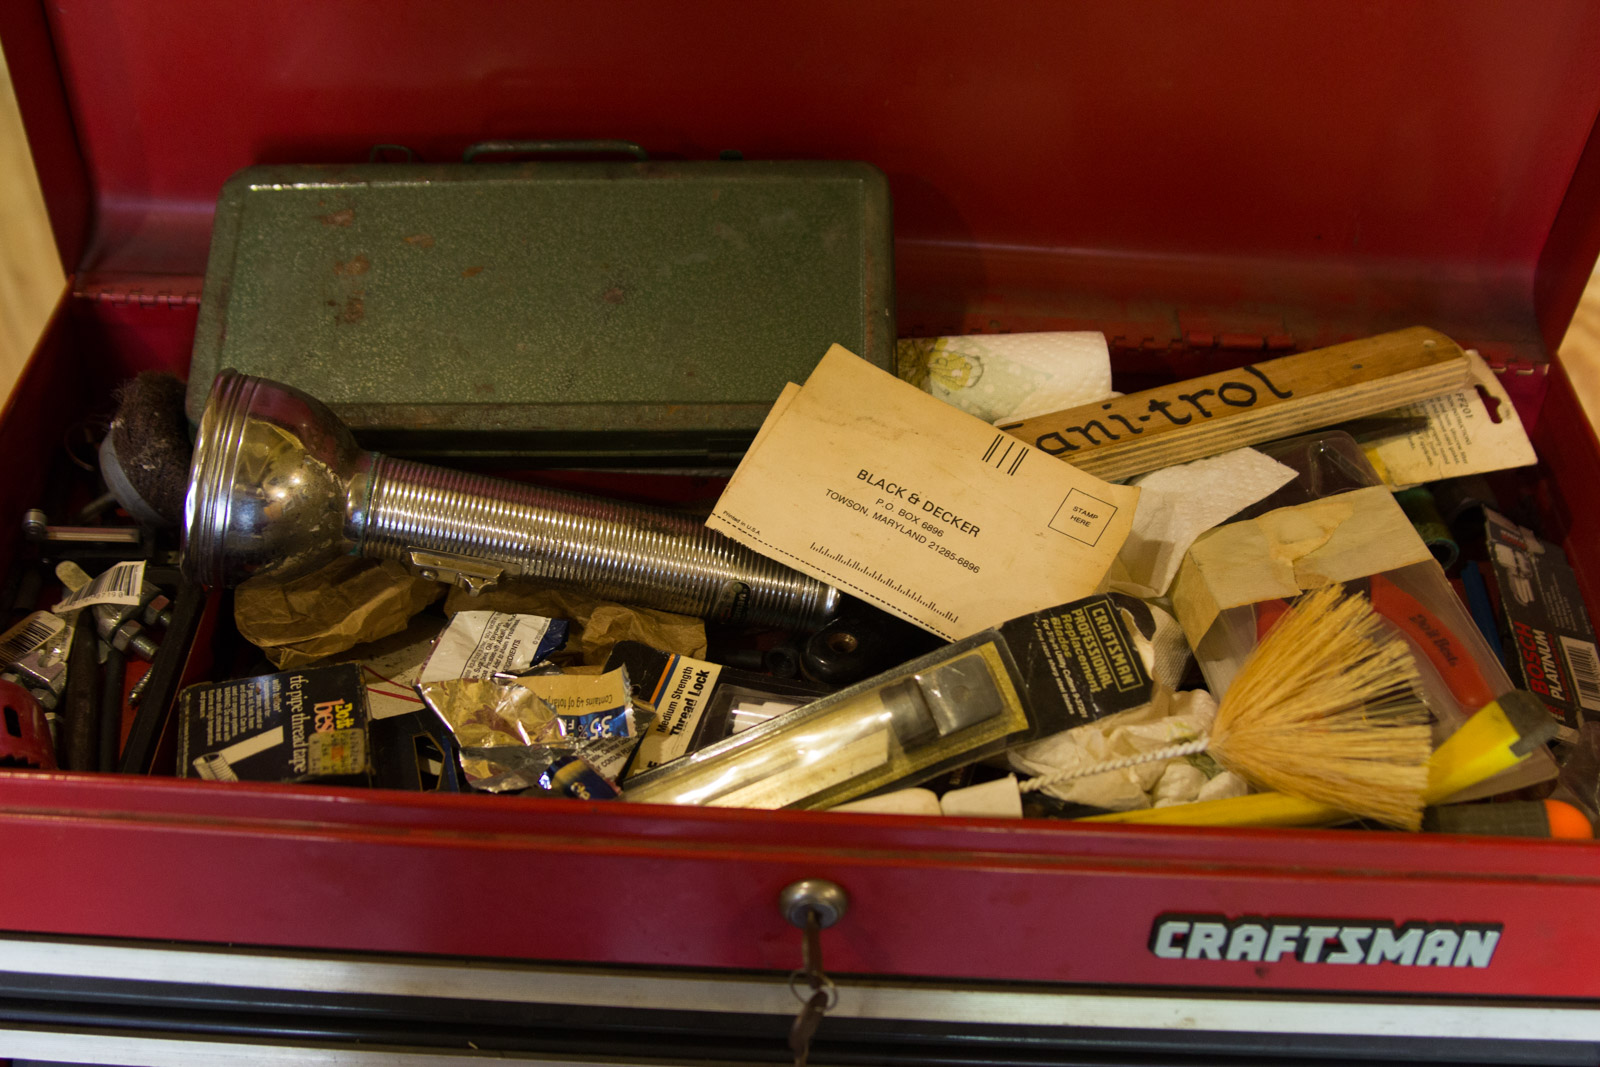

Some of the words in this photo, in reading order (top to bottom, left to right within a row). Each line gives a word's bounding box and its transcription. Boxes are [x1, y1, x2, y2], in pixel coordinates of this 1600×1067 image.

[995, 365, 1293, 454] ani-trol
[1454, 390, 1473, 420] FF201
[722, 509, 741, 524] Printed
[855, 466, 907, 501] BLACK
[906, 491, 922, 507] &
[920, 499, 982, 538] DECKER
[874, 496, 897, 513] P.O.
[896, 507, 920, 525] BOX
[920, 520, 945, 538] 6896
[1069, 513, 1091, 528] HERE
[1072, 504, 1099, 521] STAMP
[824, 487, 871, 518] TOWSON,
[870, 510, 928, 545] MARYLAND
[926, 540, 981, 575] 21285-6896
[1051, 616, 1072, 658] Blades
[1060, 614, 1102, 694] Replacement
[1071, 608, 1114, 689] PROFESSIONAL
[1092, 607, 1136, 685] CRAFTSMAN
[1514, 620, 1550, 696] BOSCH
[289, 674, 309, 689] tfe
[1047, 656, 1060, 678] sharp
[1534, 628, 1564, 701] PLATINUM
[285, 689, 308, 712] pipe
[312, 697, 345, 733] bes
[567, 696, 575, 708] of
[586, 694, 612, 706] Contains
[656, 701, 678, 733] Medium
[671, 666, 694, 700] Strength
[670, 698, 695, 735] Thread
[688, 669, 710, 696] Lock
[290, 712, 311, 747] thread
[287, 747, 307, 773] tape
[1152, 920, 1502, 968] CRAFTSMAN
